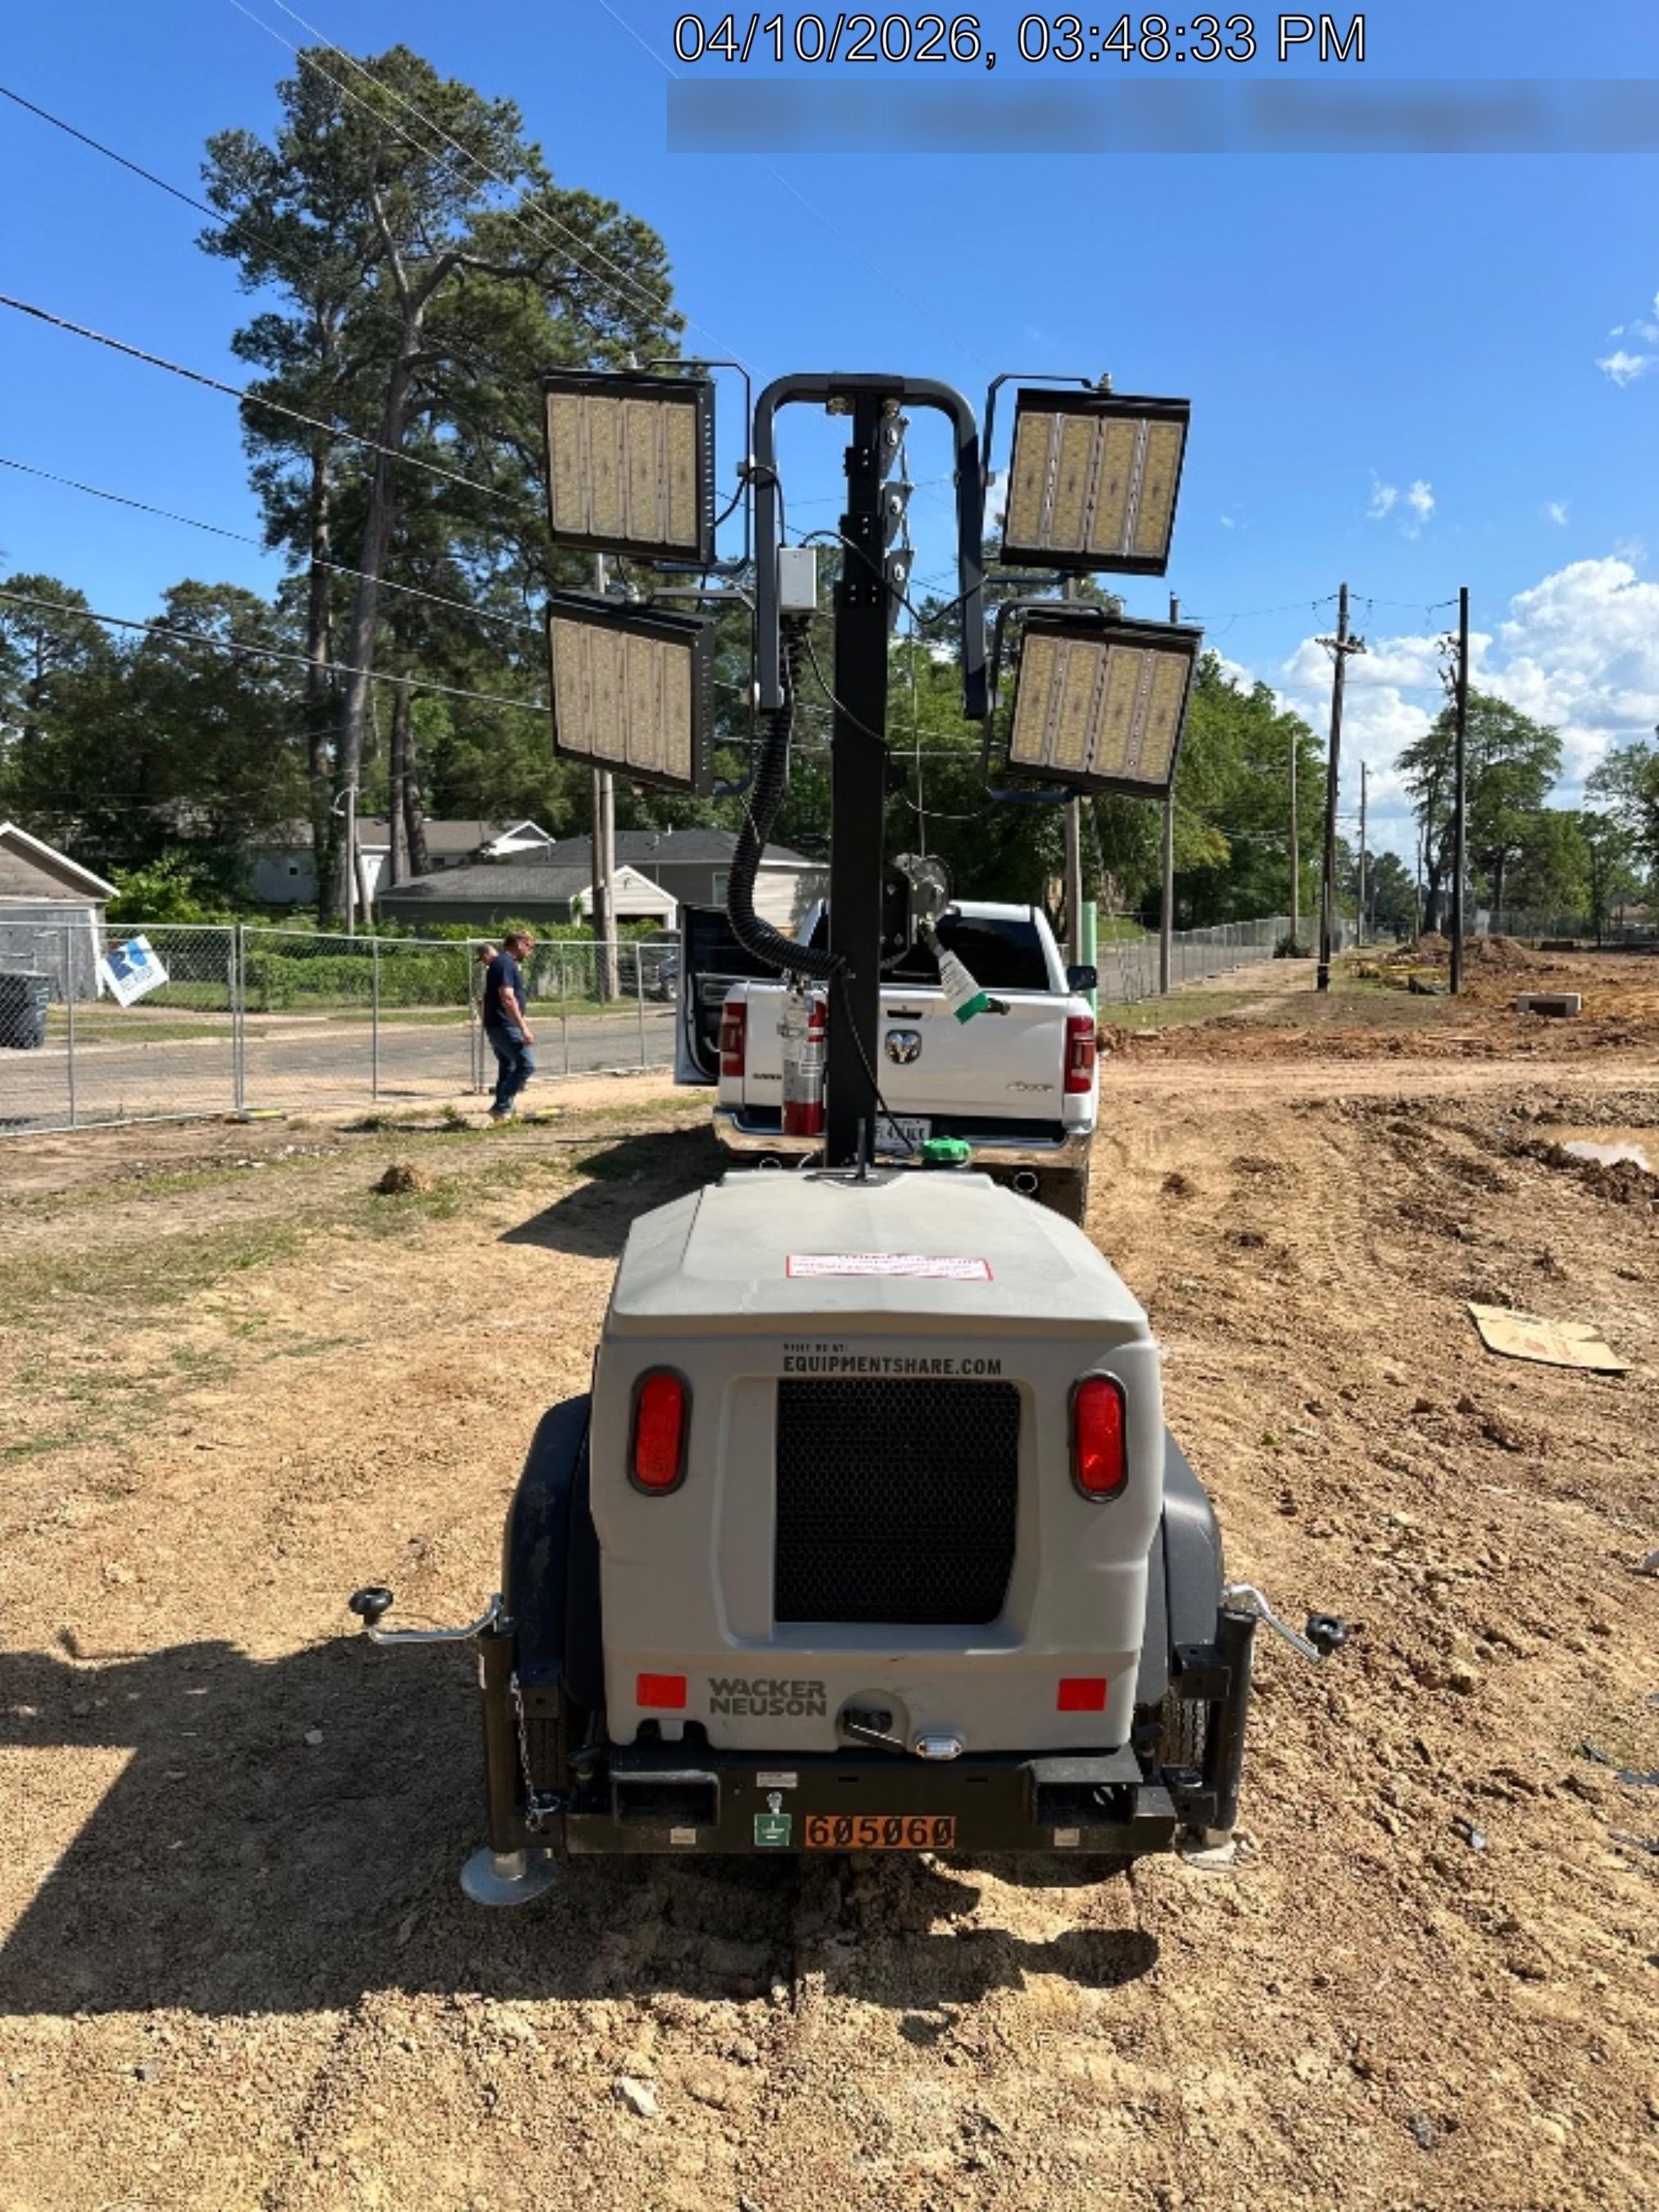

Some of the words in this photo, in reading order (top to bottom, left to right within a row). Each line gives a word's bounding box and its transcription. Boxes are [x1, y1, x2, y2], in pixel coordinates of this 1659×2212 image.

[783, 1356, 1001, 1375] EQUIPMENTSHARE.COM
[707, 1678, 827, 1699] WACKER
[709, 1698, 827, 1716] NEUSON
[808, 1816, 953, 1846] 605060
